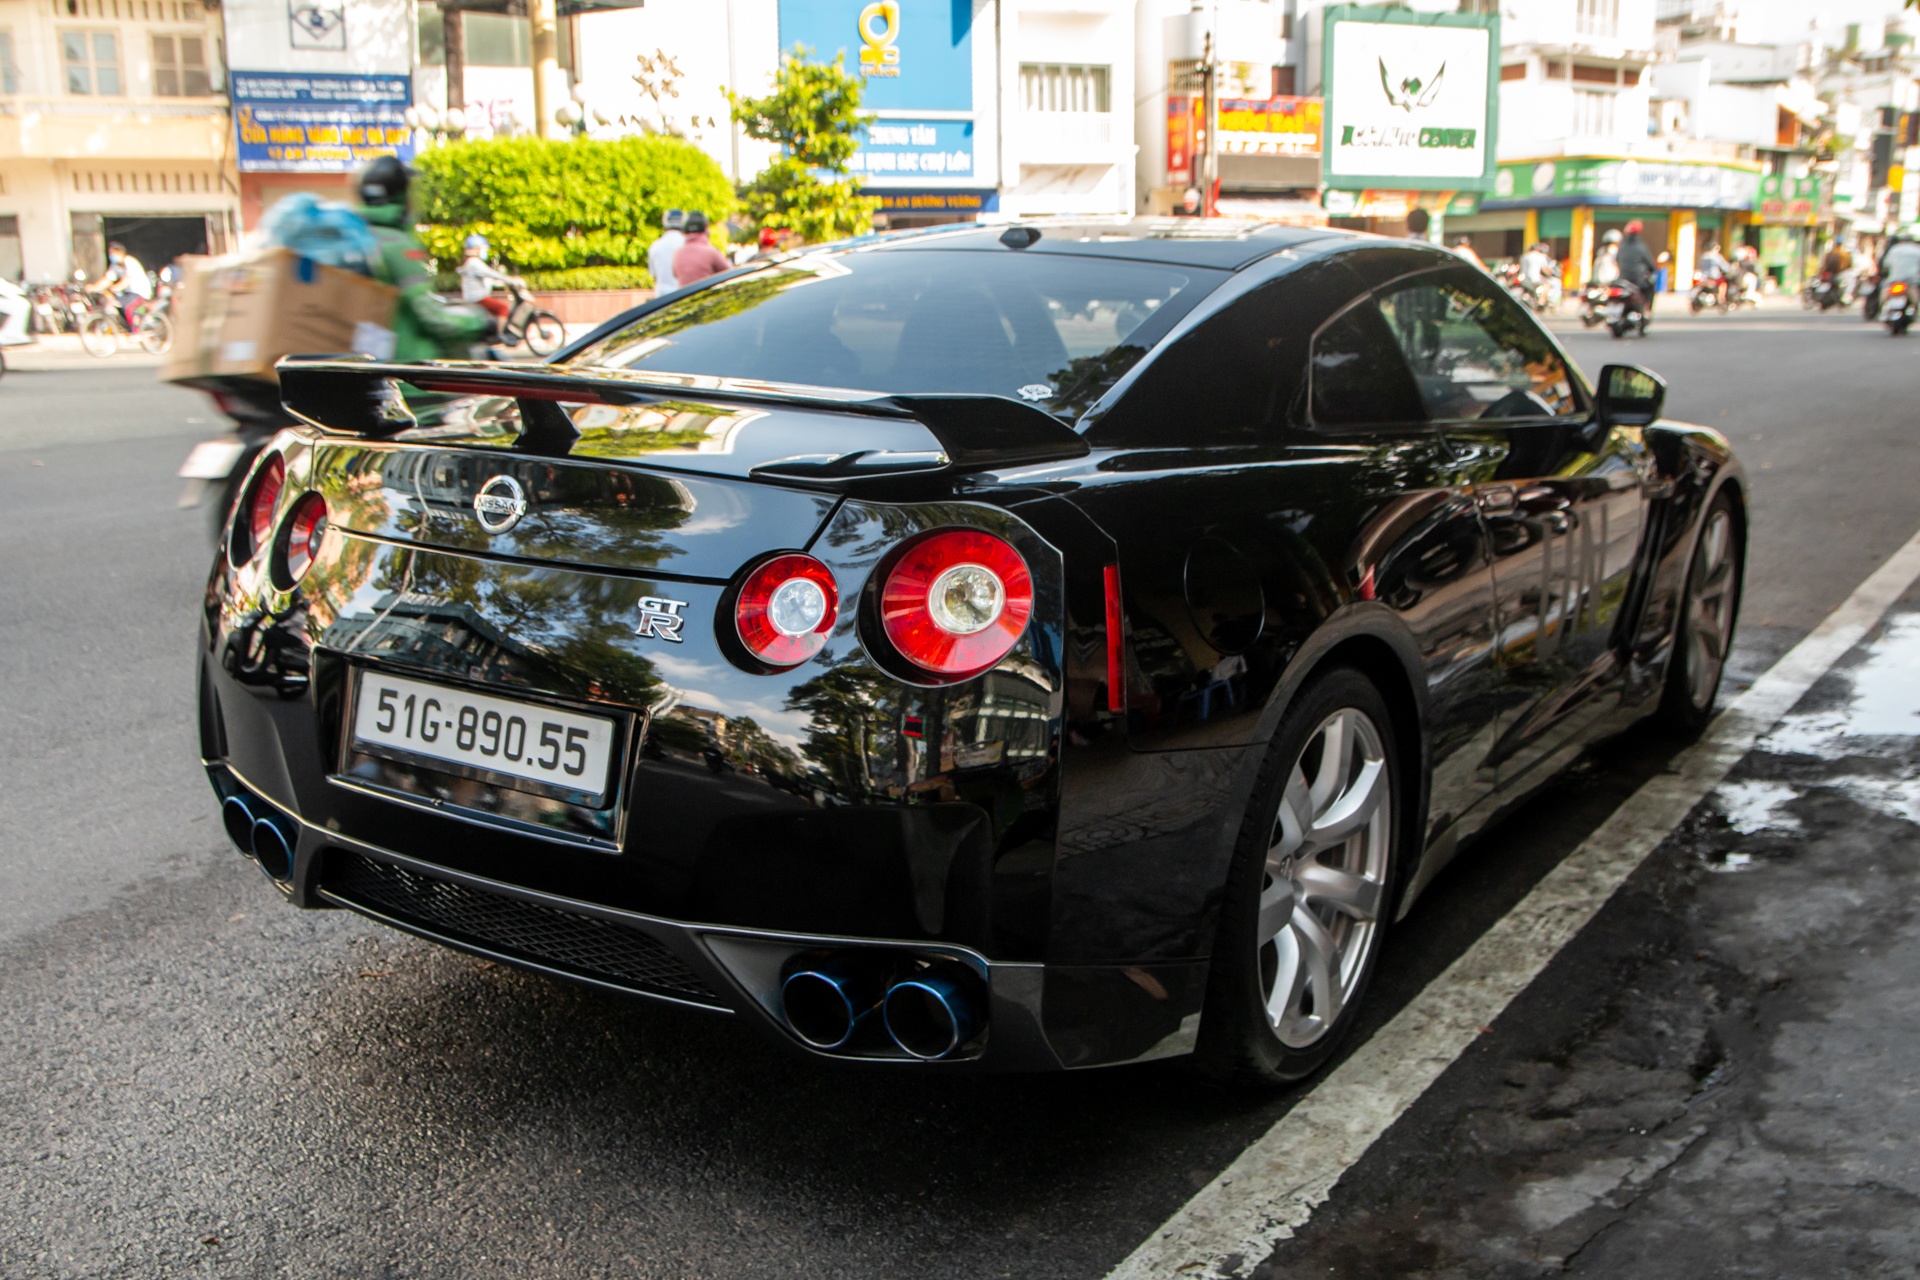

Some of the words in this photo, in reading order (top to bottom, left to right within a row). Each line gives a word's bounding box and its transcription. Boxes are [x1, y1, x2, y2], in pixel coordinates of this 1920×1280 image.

[477, 496, 518, 513] NISSAN
[637, 596, 690, 614] GT
[635, 610, 684, 642] R
[376, 688, 590, 777] 51G-890.55
